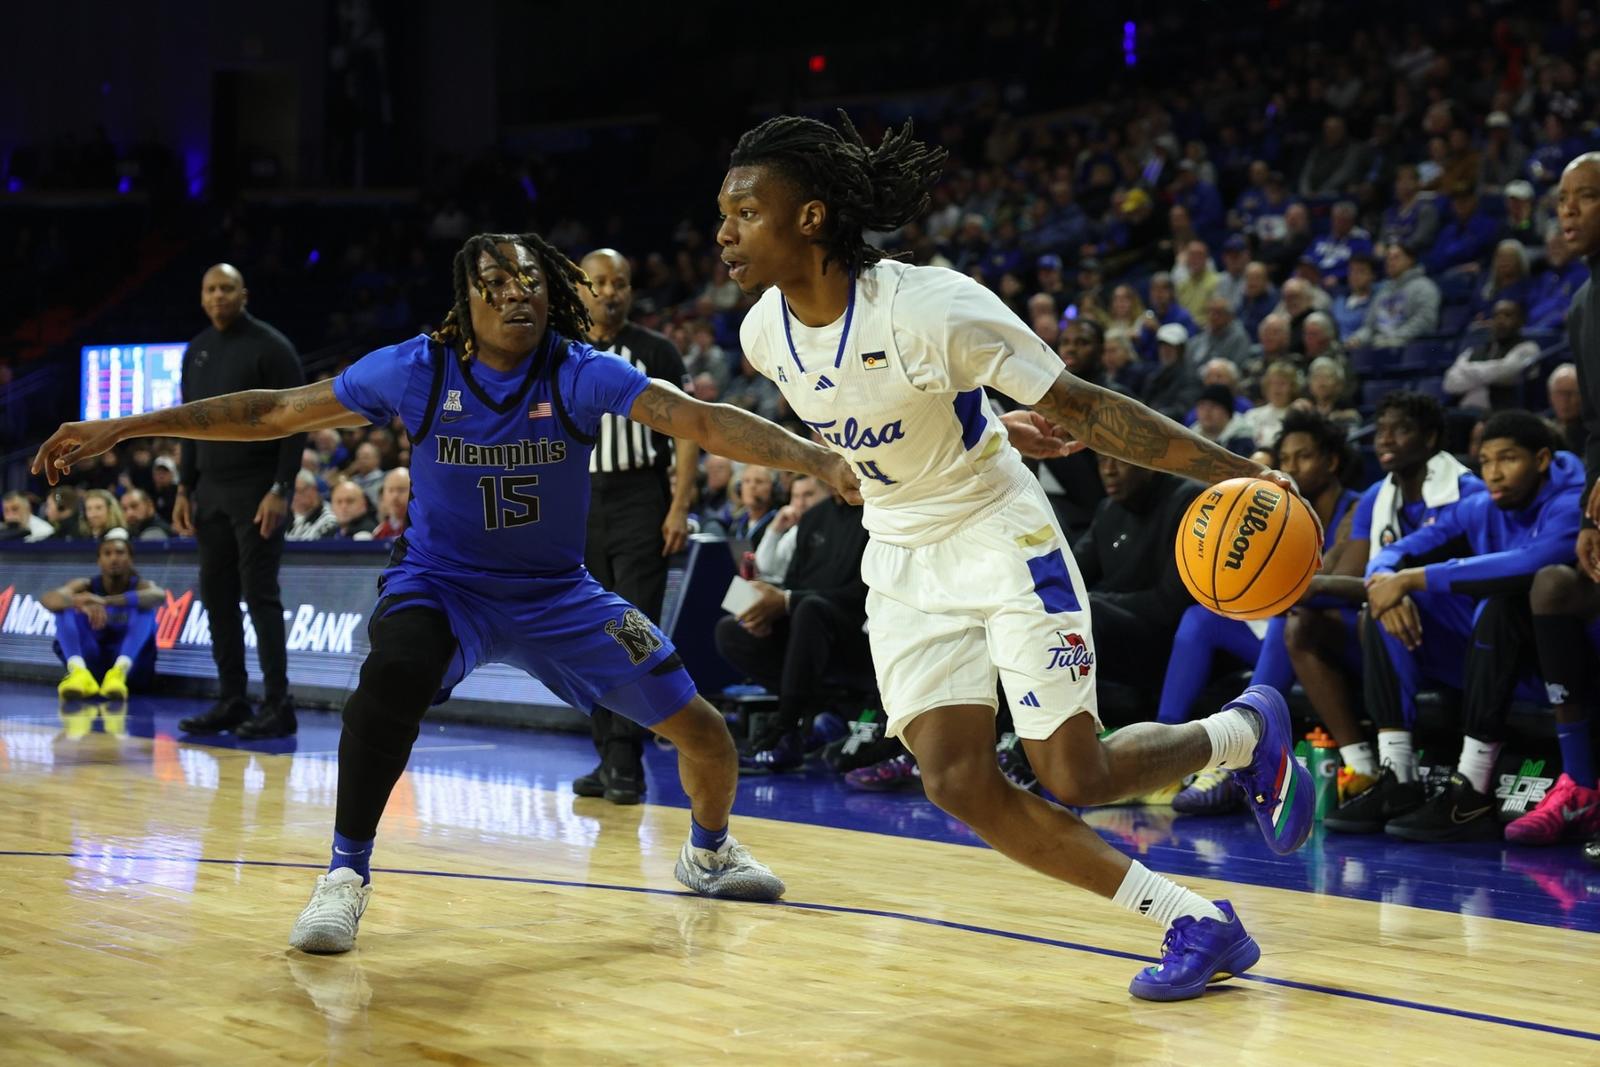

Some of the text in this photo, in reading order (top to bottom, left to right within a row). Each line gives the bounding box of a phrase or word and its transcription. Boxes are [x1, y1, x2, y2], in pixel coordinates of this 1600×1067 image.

[435, 435, 567, 470] Memphis
[803, 417, 905, 450] Tulsa
[856, 460, 898, 485] 4
[477, 475, 540, 531] 15
[1224, 488, 1281, 570] Wilson
[286, 603, 363, 654] BANK
